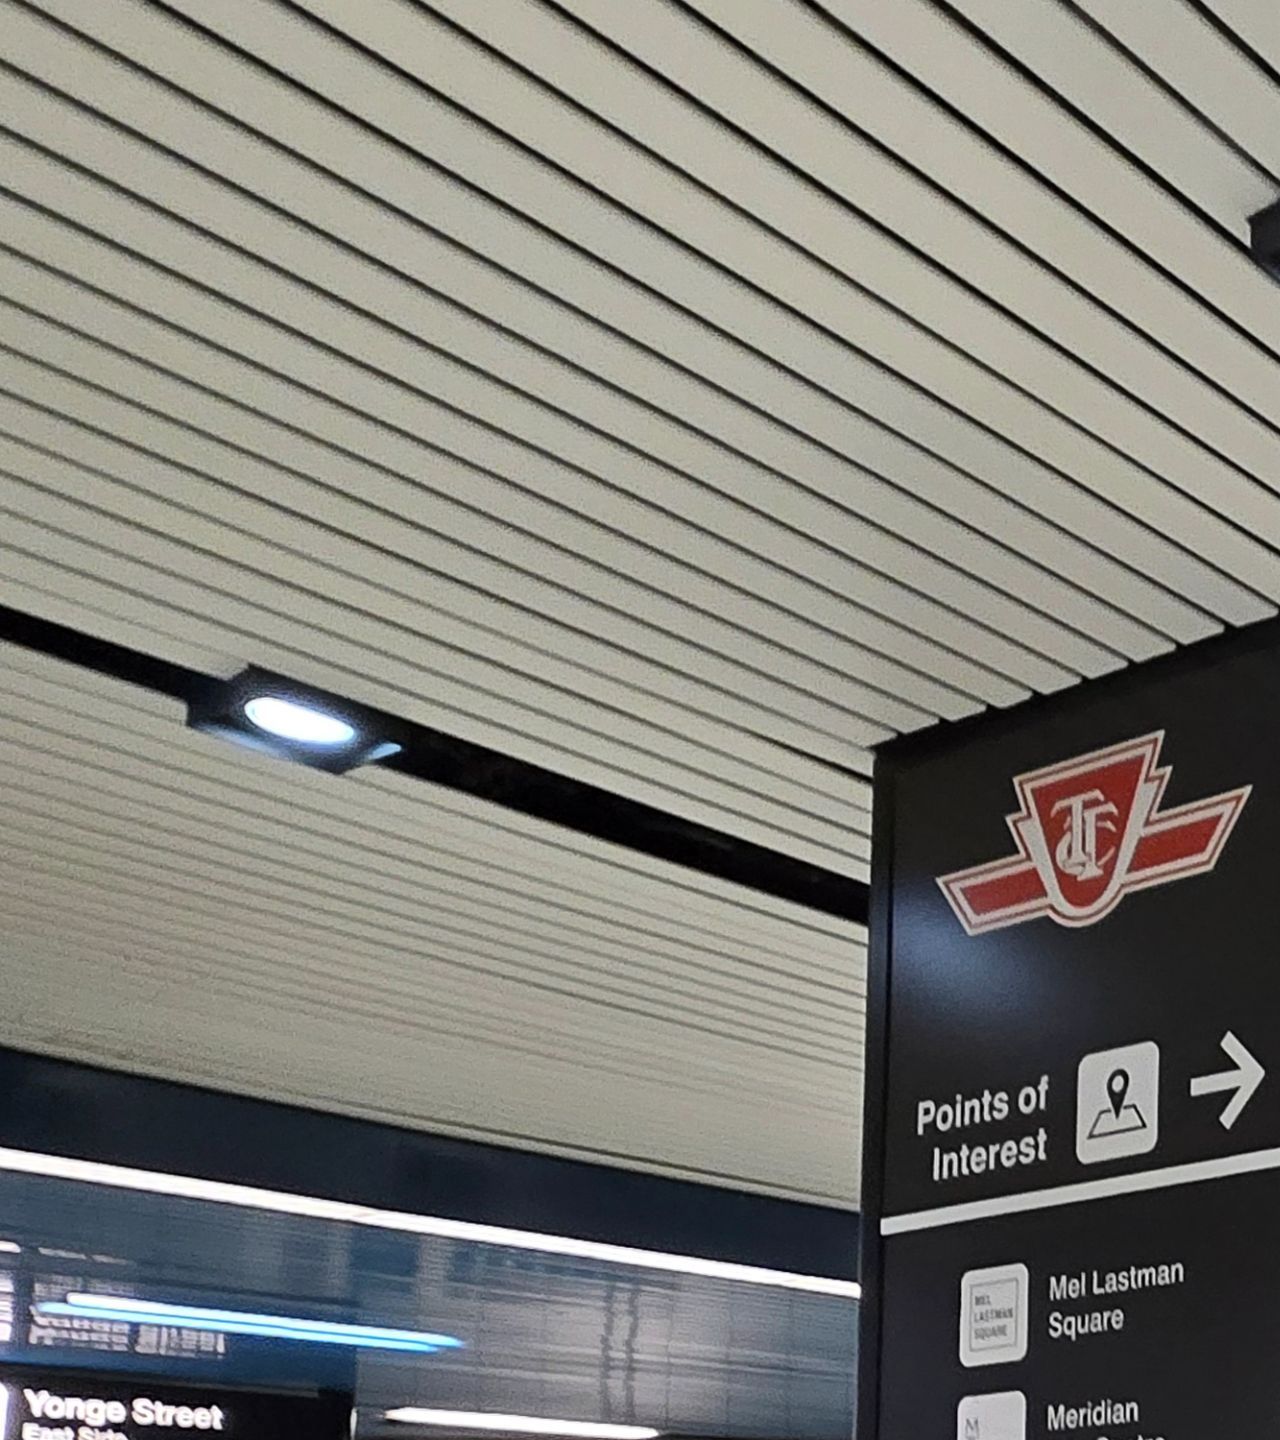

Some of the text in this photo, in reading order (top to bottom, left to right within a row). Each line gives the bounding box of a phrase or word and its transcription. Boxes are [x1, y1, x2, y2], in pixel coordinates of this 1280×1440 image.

[917, 1074, 1049, 1135] Points of
[933, 1127, 1047, 1181] Interest
[1050, 1262, 1185, 1301] Mel Lastman
[1049, 1308, 1125, 1341] Square
[23, 1389, 224, 1431] Yonge Street
[1047, 1399, 1139, 1432] Meridian
